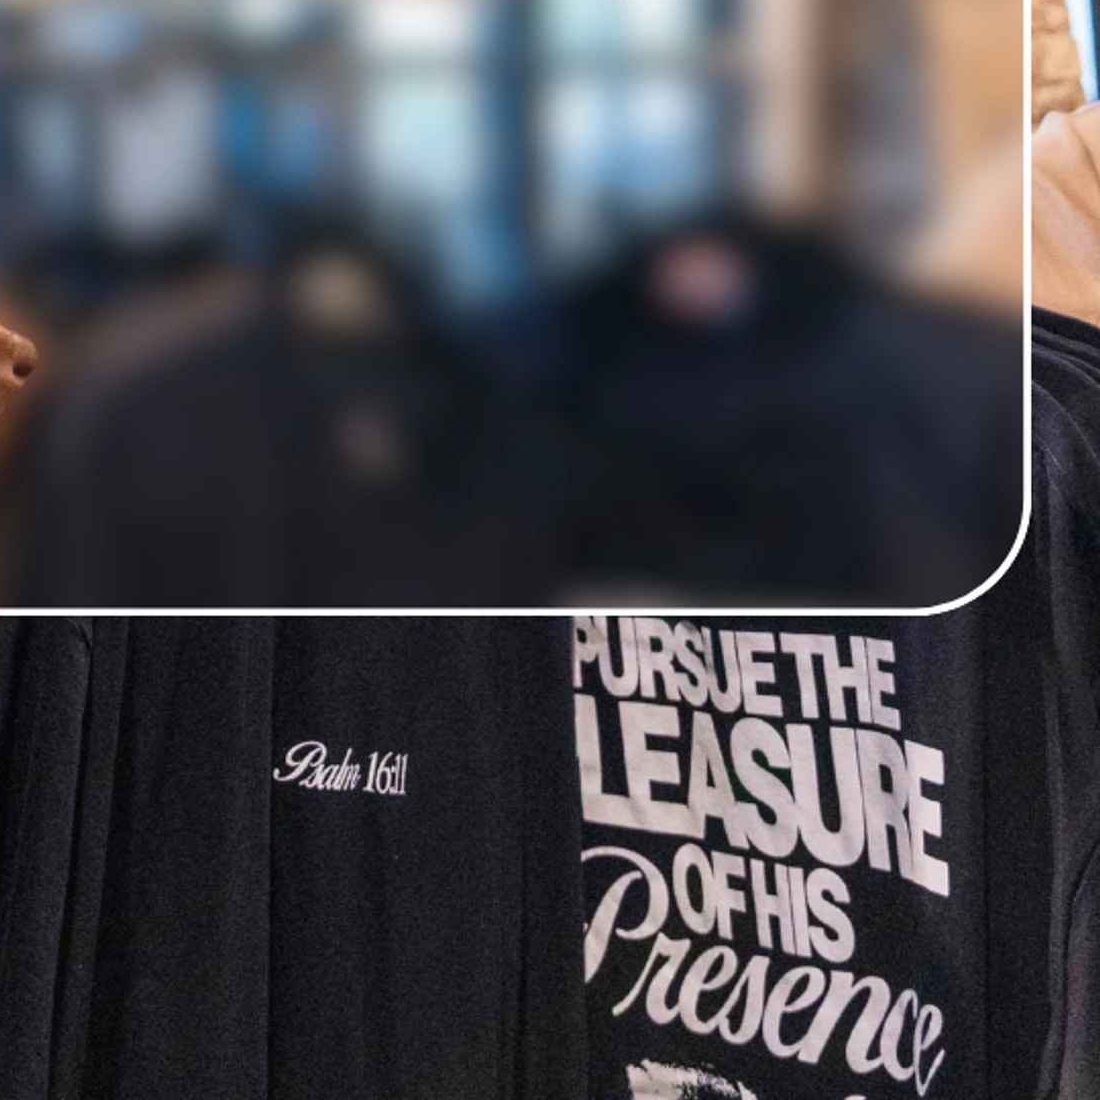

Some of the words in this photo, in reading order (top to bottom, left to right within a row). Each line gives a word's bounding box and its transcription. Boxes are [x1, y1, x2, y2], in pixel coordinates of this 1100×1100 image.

[573, 616, 783, 717] PURSUE
[780, 631, 900, 731] THE
[273, 740, 361, 791] Psalm
[672, 843, 747, 940] OF
[750, 858, 856, 963] HIS
[581, 845, 944, 1097] Presence
